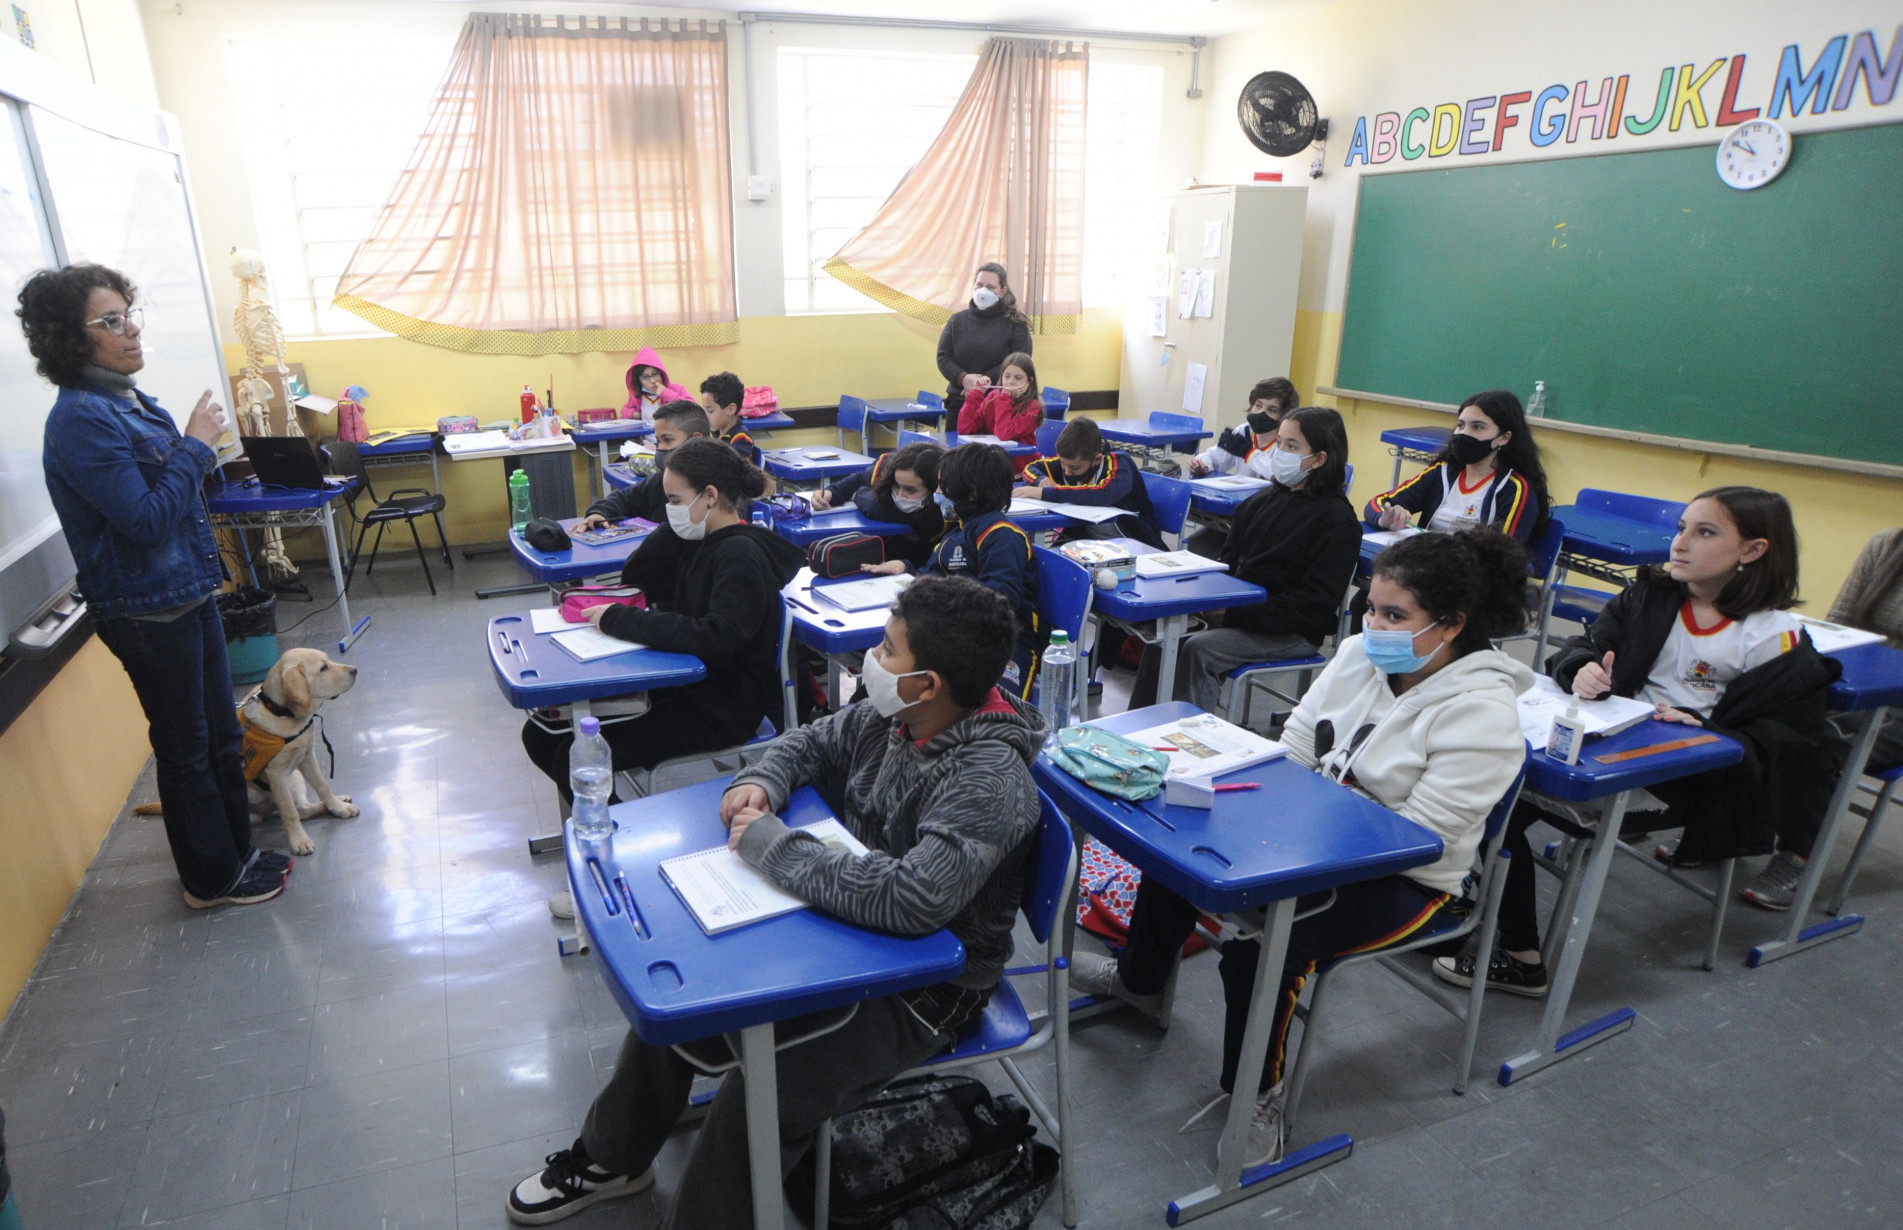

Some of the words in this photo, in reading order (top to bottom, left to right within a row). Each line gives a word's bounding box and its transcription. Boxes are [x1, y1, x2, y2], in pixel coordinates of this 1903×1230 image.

[1753, 124, 1762, 132] 12
[1741, 128, 1748, 137] 11
[1737, 171, 1742, 179] 7
